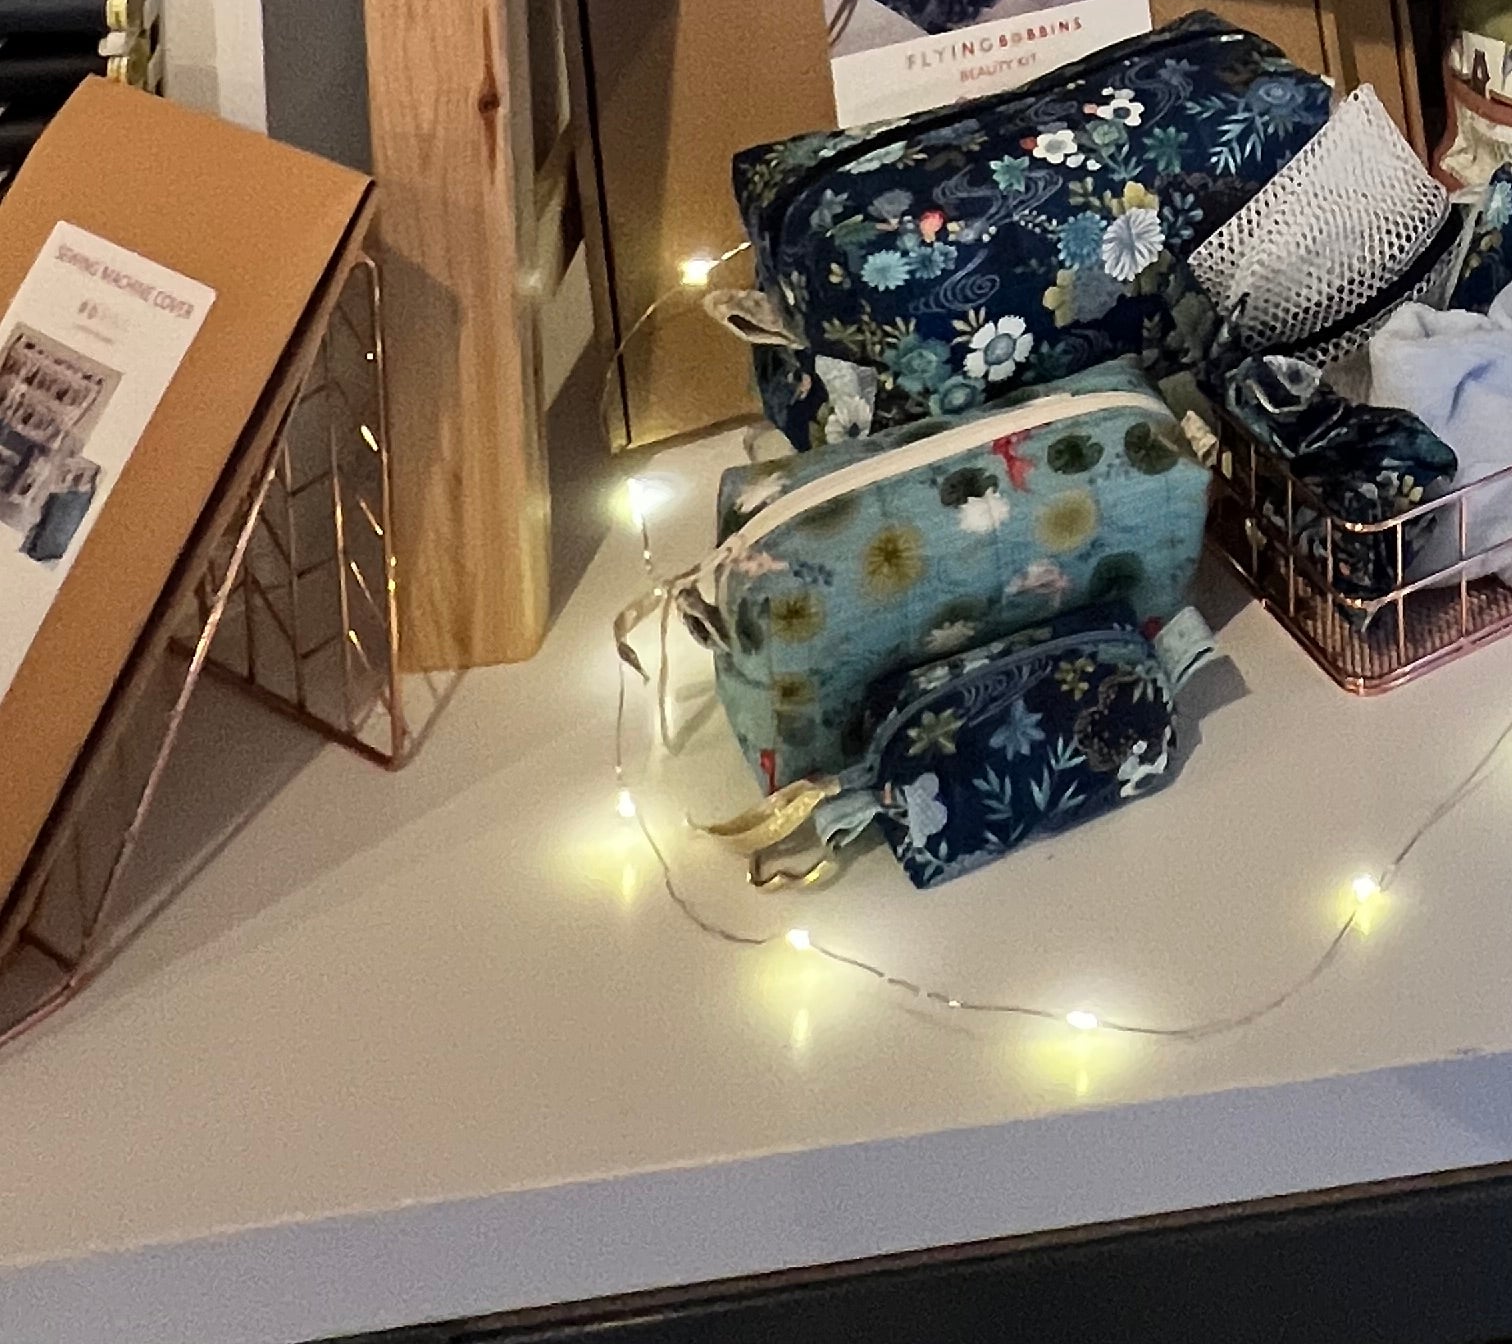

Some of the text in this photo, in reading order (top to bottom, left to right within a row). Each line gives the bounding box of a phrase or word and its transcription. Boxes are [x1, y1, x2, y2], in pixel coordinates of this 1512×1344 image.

[960, 53, 1037, 83] BEAUTY KIT
[153, 291, 194, 319] COVER
